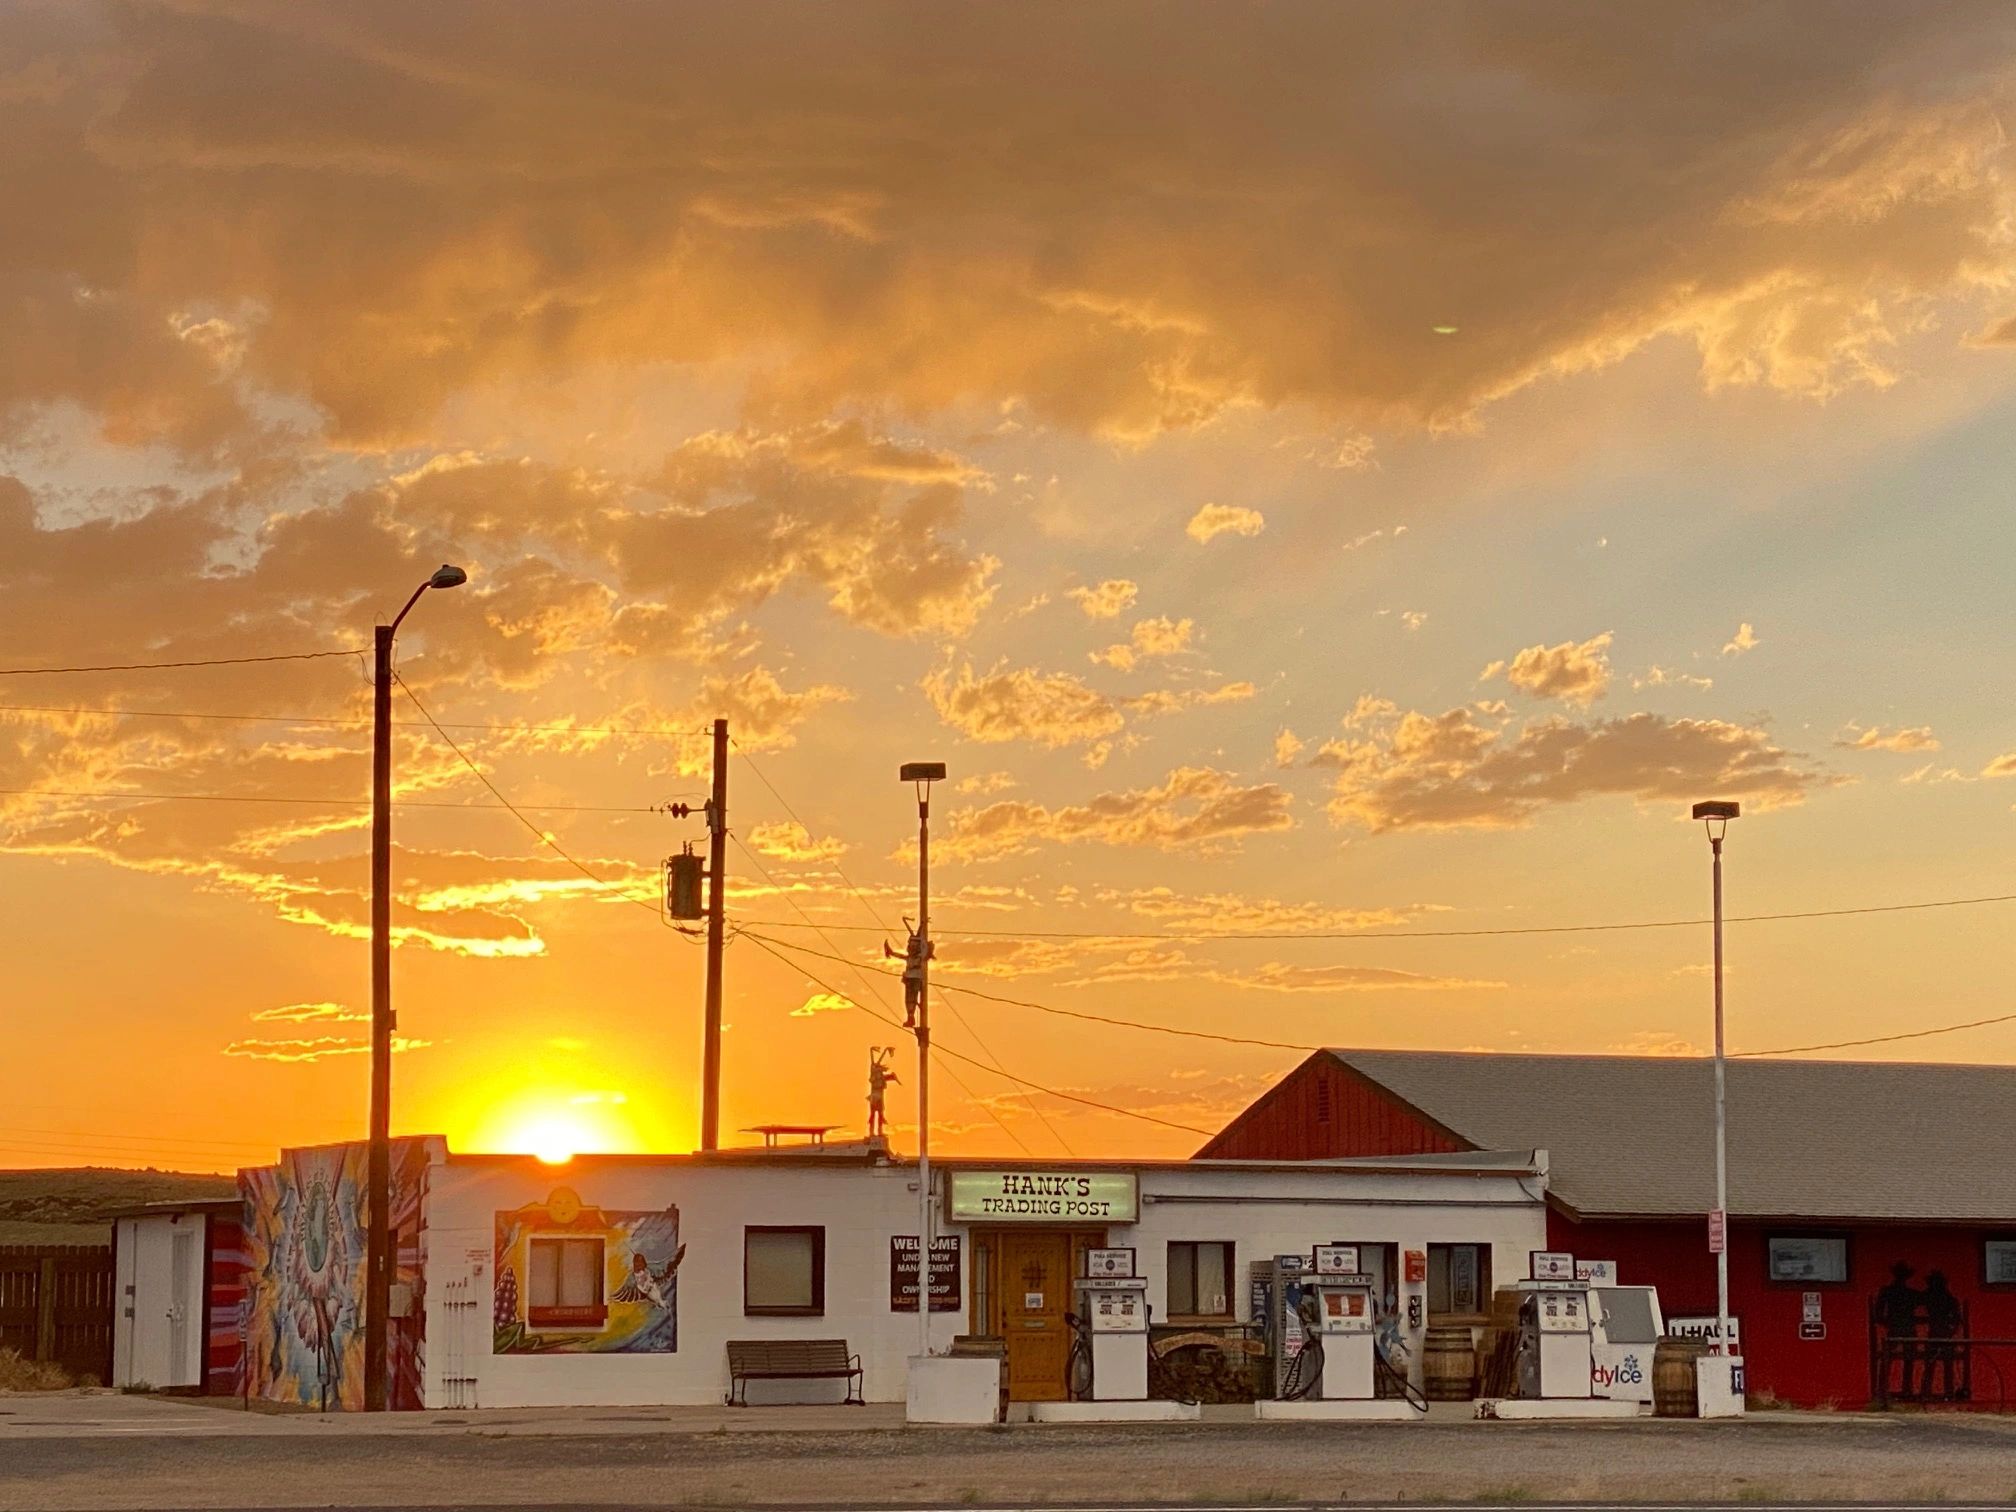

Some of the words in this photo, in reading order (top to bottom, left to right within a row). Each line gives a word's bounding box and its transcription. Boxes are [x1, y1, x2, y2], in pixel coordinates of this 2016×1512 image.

[1002, 1175, 1091, 1197] HANK'S
[982, 1198, 1061, 1214] TRADING
[1066, 1201, 1110, 1216] POST
[893, 1238, 958, 1250] WELOME
[931, 1253, 950, 1262] NEW
[897, 1263, 955, 1273] MANAEMENT
[902, 1285, 950, 1294] OWNRSHIP
